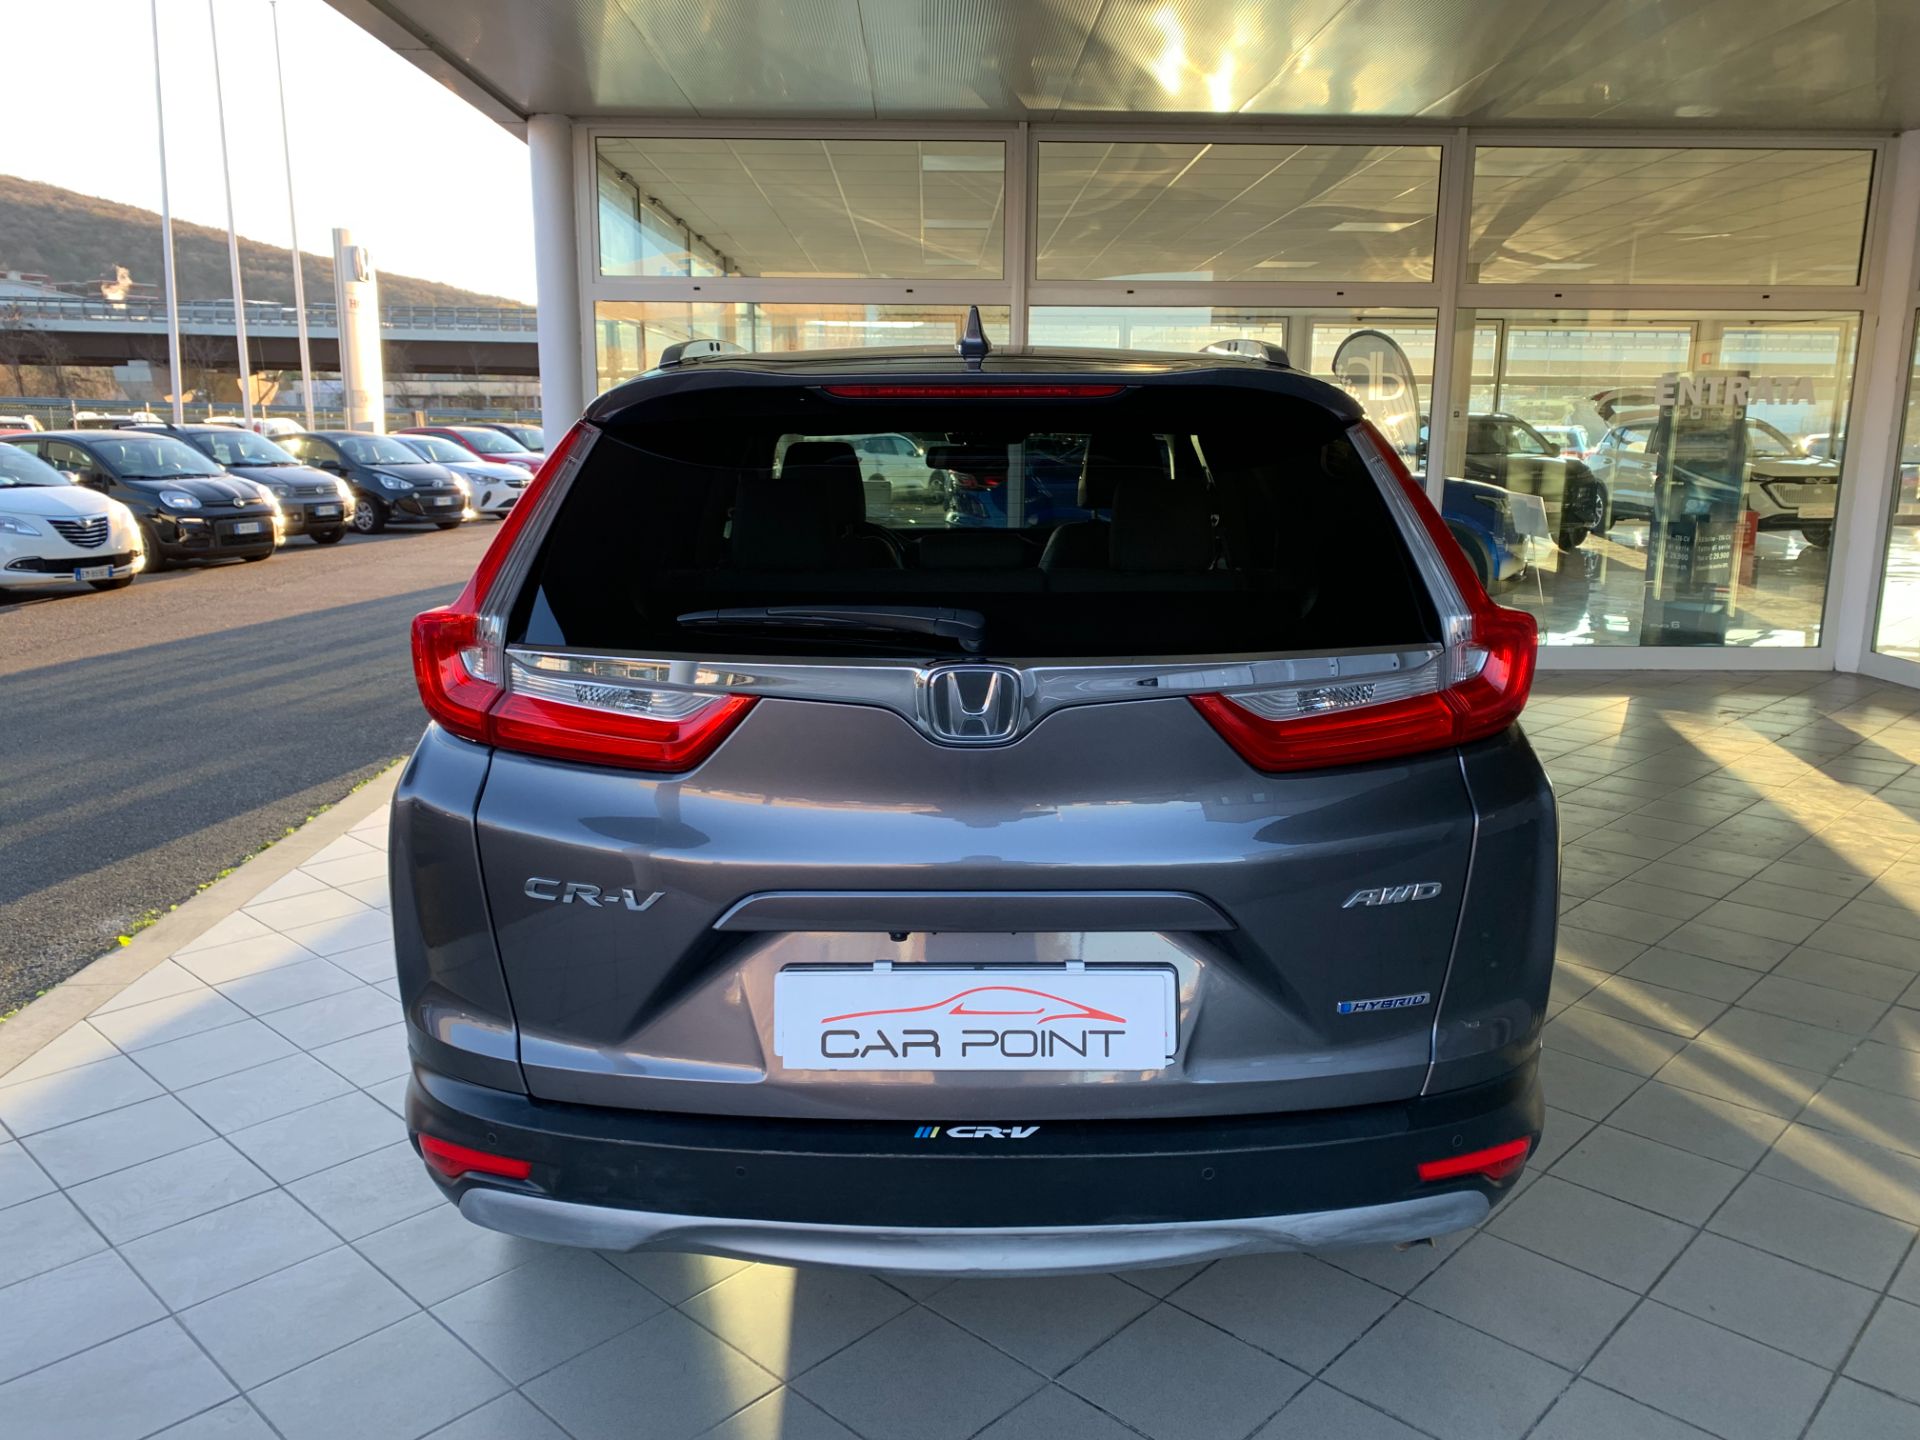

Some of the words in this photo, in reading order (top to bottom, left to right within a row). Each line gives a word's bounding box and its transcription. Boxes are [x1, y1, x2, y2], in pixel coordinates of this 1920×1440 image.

[1654, 376, 1817, 406] ENTRATA
[524, 877, 666, 911] CR-V
[1342, 882, 1442, 909] AWD
[1353, 995, 1426, 1011] HYBRID
[821, 1029, 941, 1059] CAR
[961, 1029, 1126, 1058] POINT
[946, 1125, 1041, 1139] CR-V
